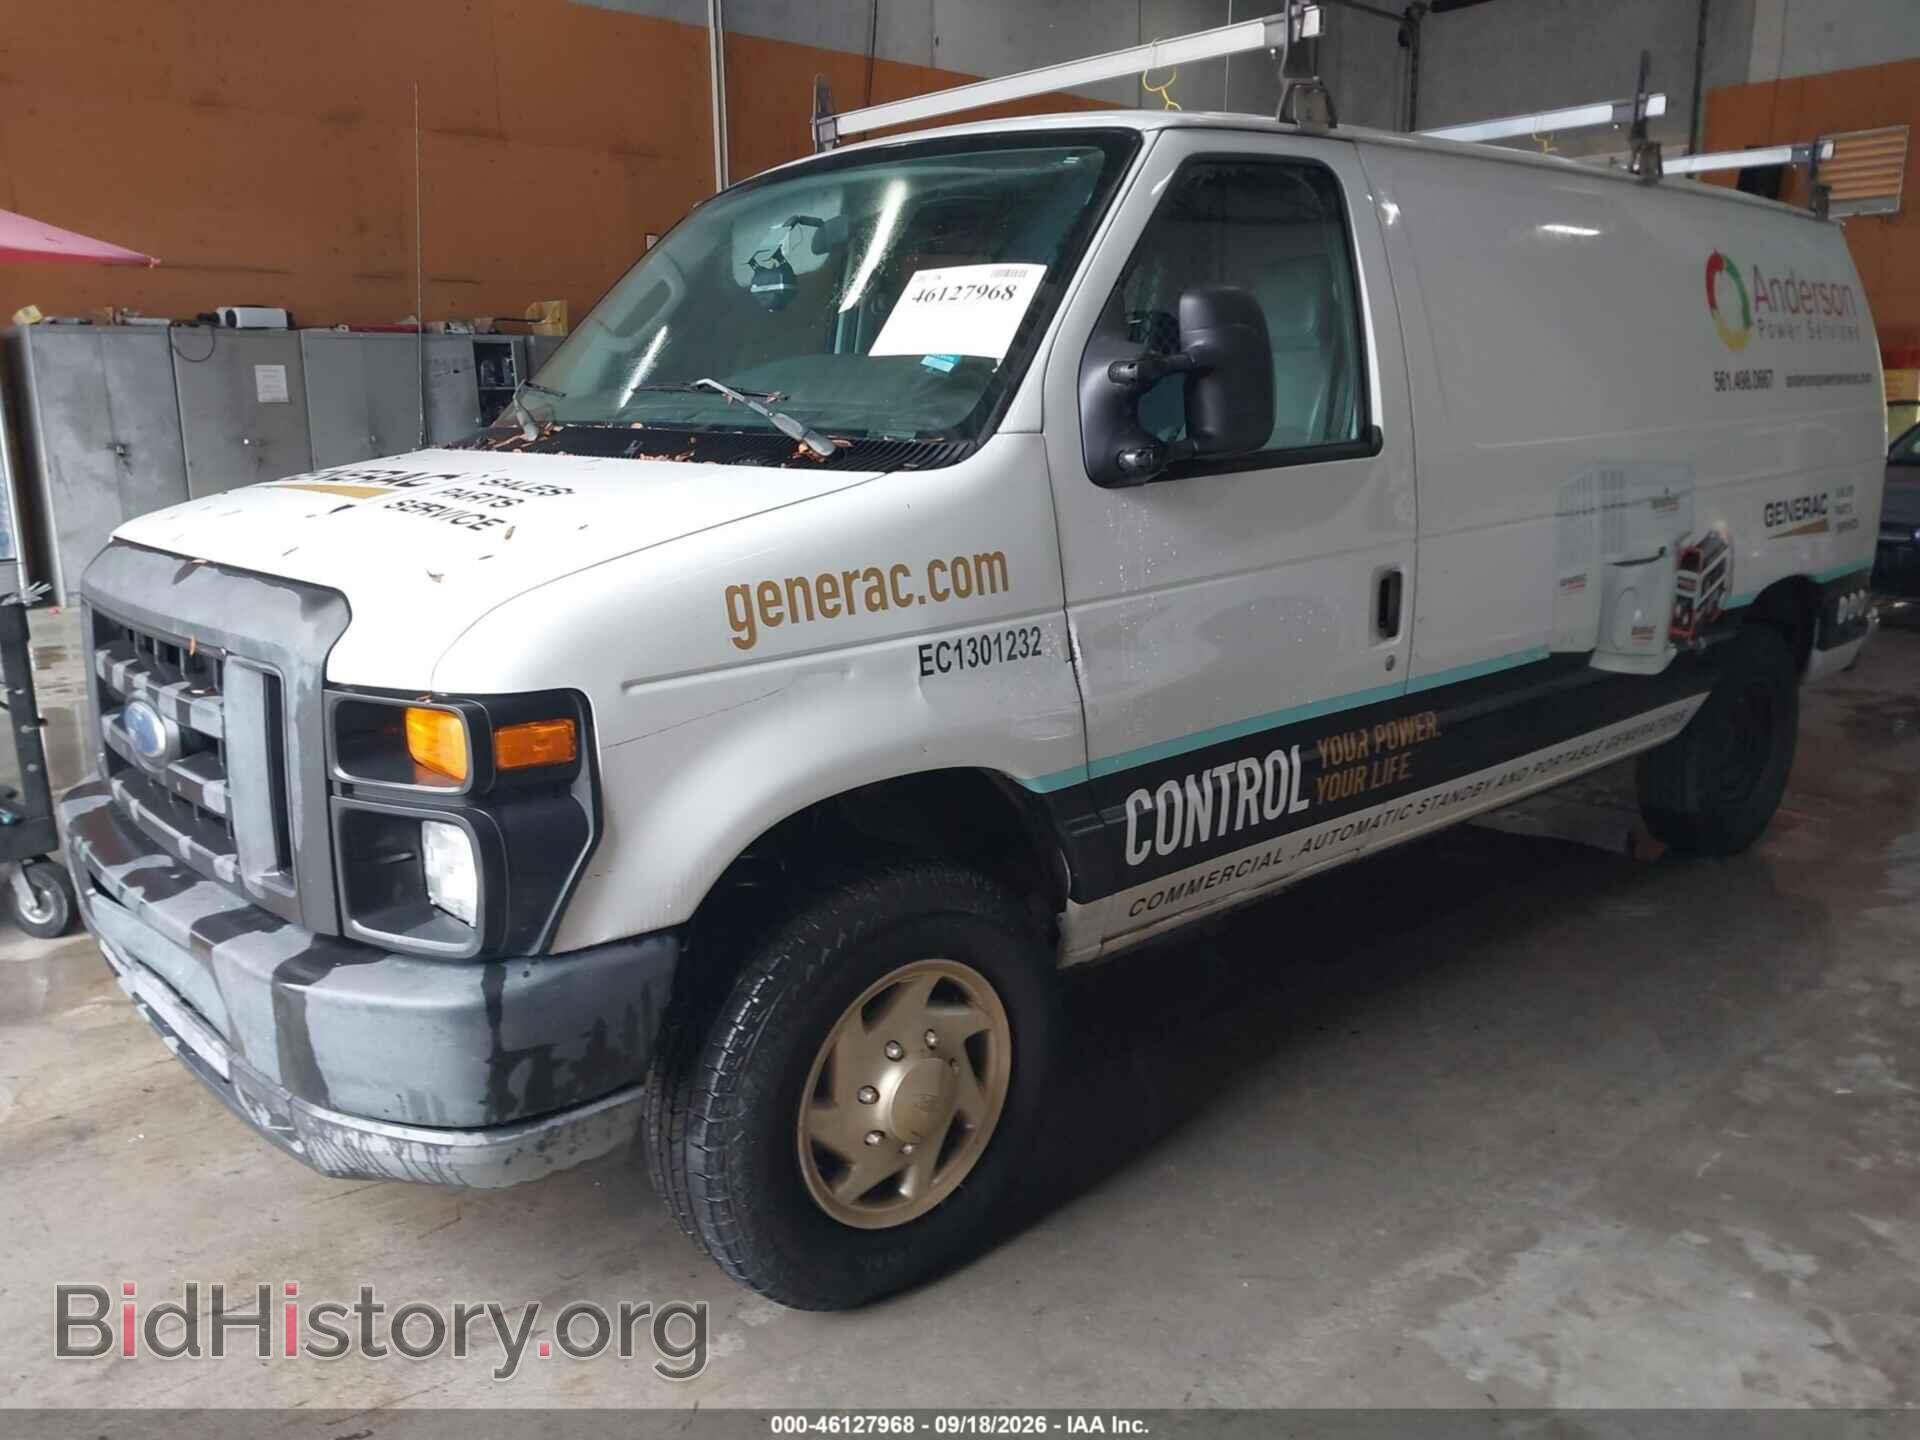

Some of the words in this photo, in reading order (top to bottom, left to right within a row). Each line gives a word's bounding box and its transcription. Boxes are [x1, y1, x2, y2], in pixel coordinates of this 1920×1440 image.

[912, 284, 1017, 303] 46127968
[1753, 264, 1857, 317] Anderson
[430, 488, 525, 508] PARTS
[478, 478, 575, 496] SALES
[383, 499, 507, 531] SERVICE
[1764, 492, 1828, 529] GENERAC
[724, 550, 1009, 650] generac.com
[918, 626, 1042, 677] EC1301232
[1317, 729, 1369, 769] YOUR
[1316, 765, 1368, 805] YOUR
[1370, 752, 1413, 788] LIFE
[1125, 745, 1310, 866] CONTROL
